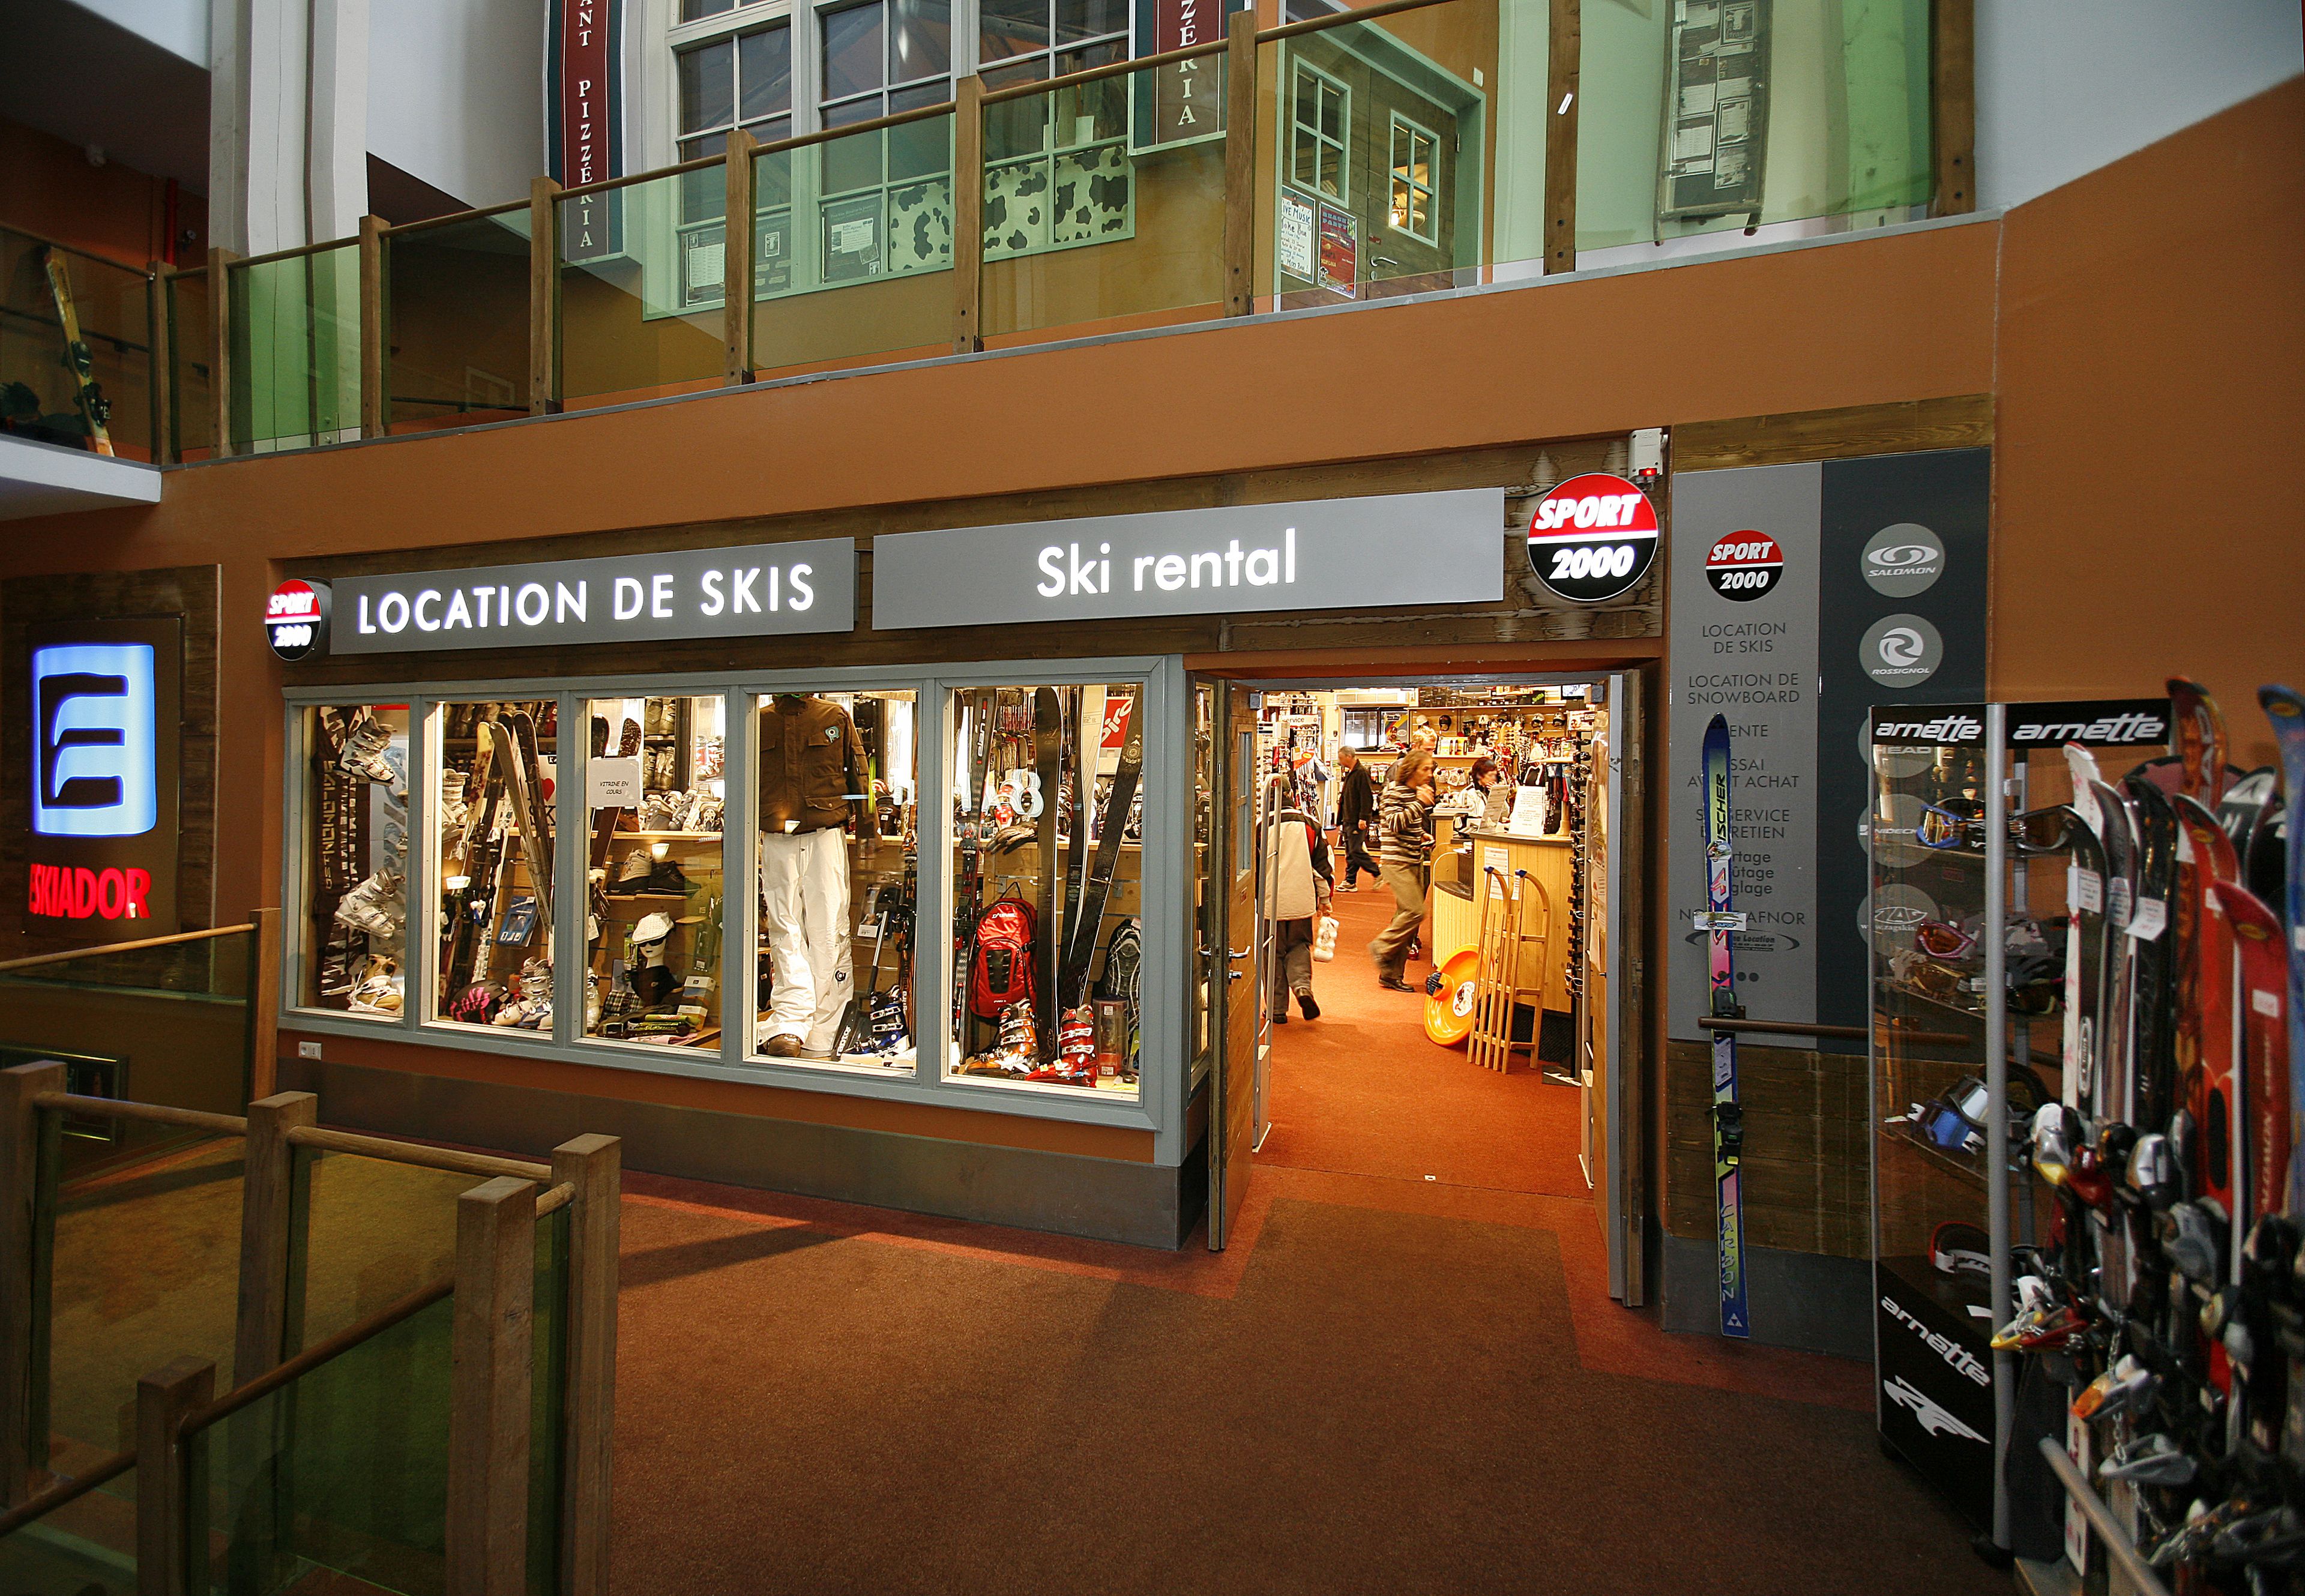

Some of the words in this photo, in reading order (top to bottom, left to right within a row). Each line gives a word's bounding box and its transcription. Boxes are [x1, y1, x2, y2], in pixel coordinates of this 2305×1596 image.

[1534, 492, 1642, 531] SPORT
[1711, 541, 1774, 561] SPORT
[1037, 543, 1110, 598] Ski
[1134, 528, 1296, 592] rental
[1547, 546, 1635, 580] 2000
[1719, 571, 1769, 589] 2000
[1868, 567, 1936, 577] SALOMON
[270, 592, 316, 615] SPORT
[359, 580, 587, 634] LOCATION
[615, 574, 673, 621] DE
[701, 564, 815, 617] SKIS
[274, 625, 312, 648] 2000
[1702, 622, 1786, 637] LOCATION
[1714, 641, 1734, 654] DE
[1739, 639, 1773, 653] SKIS
[1689, 674, 1772, 688] LOCATION
[1779, 673, 1798, 686] DE
[1688, 690, 1800, 705] SNOWBOARD
[1730, 724, 1768, 737] ENTE
[1876, 715, 1981, 743] arnette
[2013, 712, 2165, 742] arnette
[1731, 759, 1764, 771] SSAI
[1745, 775, 1799, 788] ACHAT
[1716, 773, 1727, 842] ISCHER
[1731, 809, 1790, 822] ERVICE
[1732, 851, 1771, 866] rtage
[1732, 866, 1774, 882] ûtage
[29, 863, 151, 920] ESKIADOR
[1732, 881, 1773, 897] glage
[1746, 911, 1805, 925] AFNOR
[1743, 935, 1776, 944] Location
[1720, 1203, 1735, 1302] CARBON
[1881, 1295, 1990, 1387] arnette
